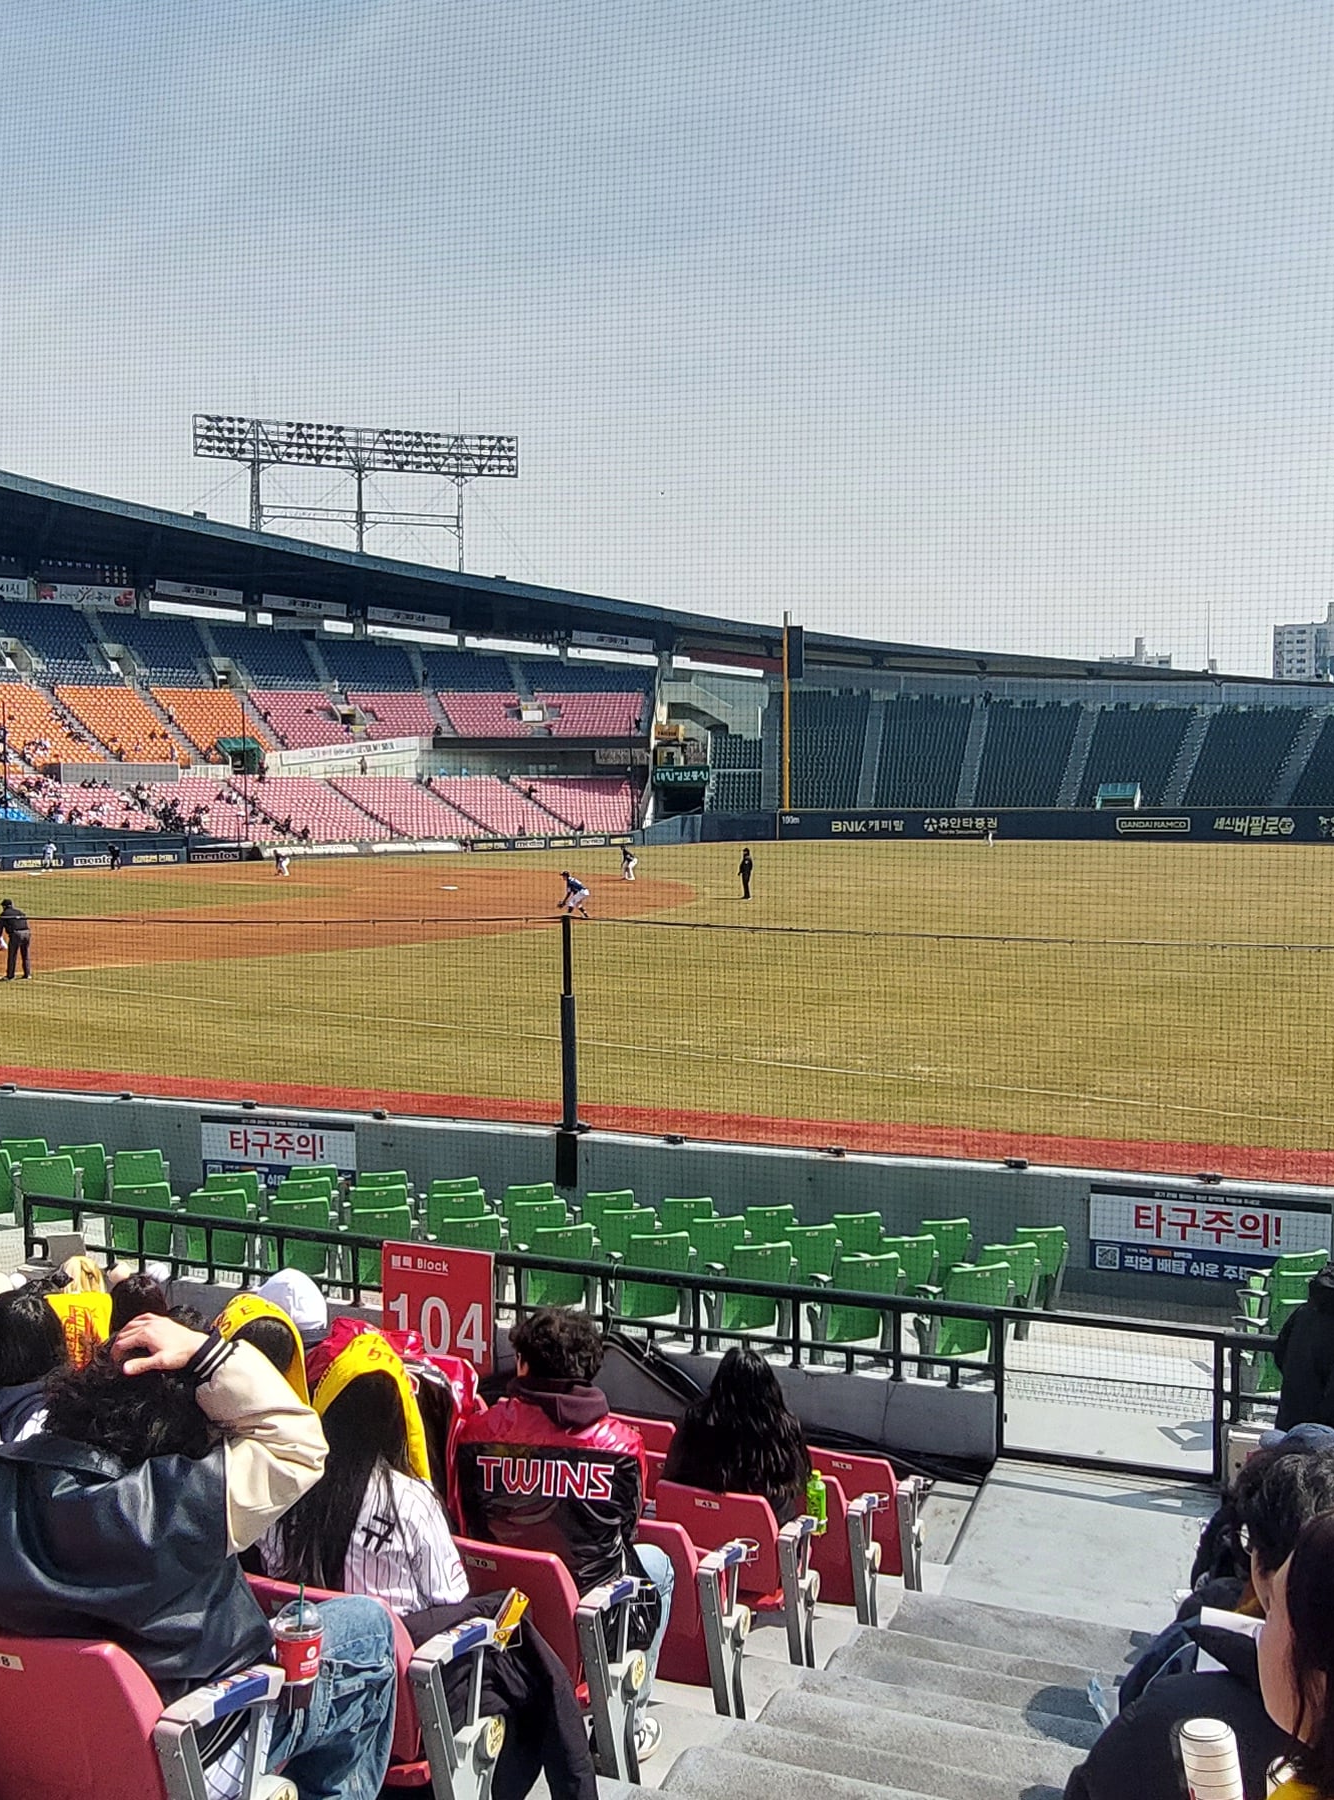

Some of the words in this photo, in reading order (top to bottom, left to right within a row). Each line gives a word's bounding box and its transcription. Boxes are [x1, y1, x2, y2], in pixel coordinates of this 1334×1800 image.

[781, 815, 801, 826] 100m
[938, 817, 998, 829] 유안타증권
[1214, 816, 1280, 837] 세신버팔로
[74, 855, 113, 866] mento
[190, 851, 240, 862] mentos
[229, 1129, 324, 1162] 타구주의!
[1134, 1204, 1281, 1249] 타구주의!
[416, 1257, 449, 1273] Block
[1124, 1255, 1154, 1272] 픽업
[1156, 1257, 1187, 1275] 배달
[1189, 1263, 1220, 1279] 쉬운
[389, 1293, 488, 1365] 104
[476, 1454, 615, 1501] TWINS
